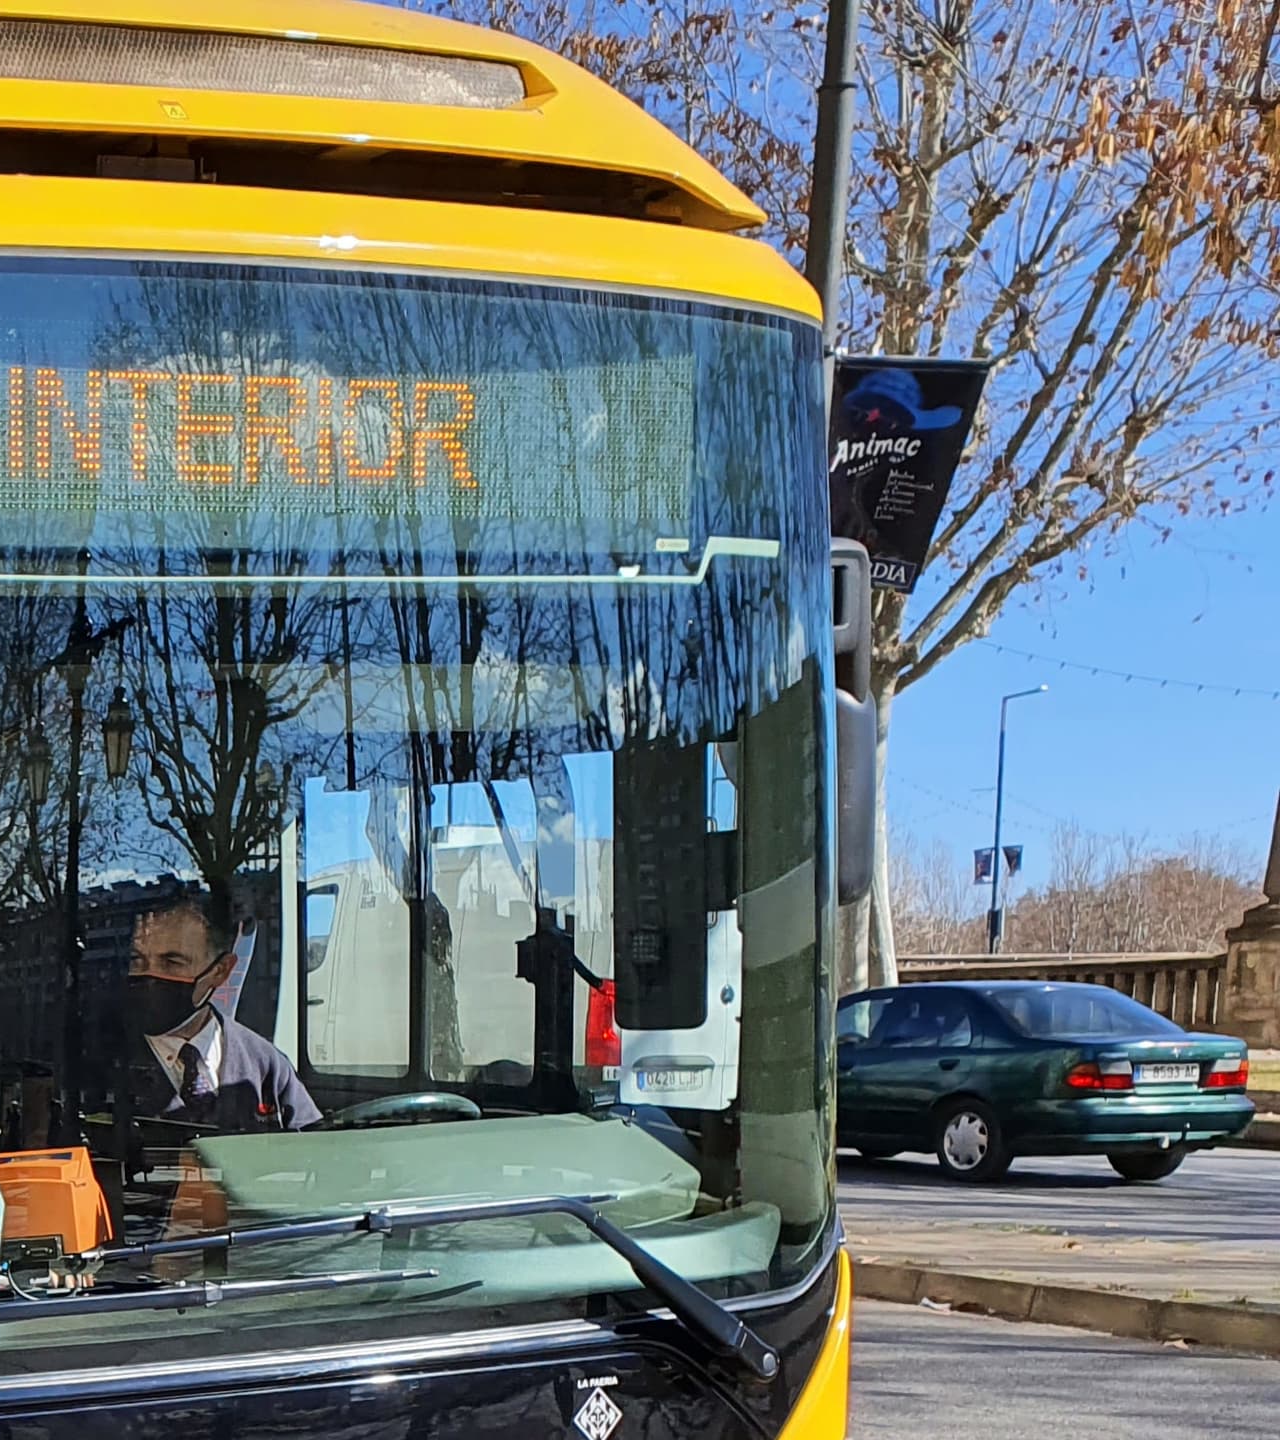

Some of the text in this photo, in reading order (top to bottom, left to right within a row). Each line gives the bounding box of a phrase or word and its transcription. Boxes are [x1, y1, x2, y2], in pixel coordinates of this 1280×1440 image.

[8, 366, 478, 489] INTERIOR
[830, 432, 922, 472] Animac
[869, 561, 906, 583] DIA
